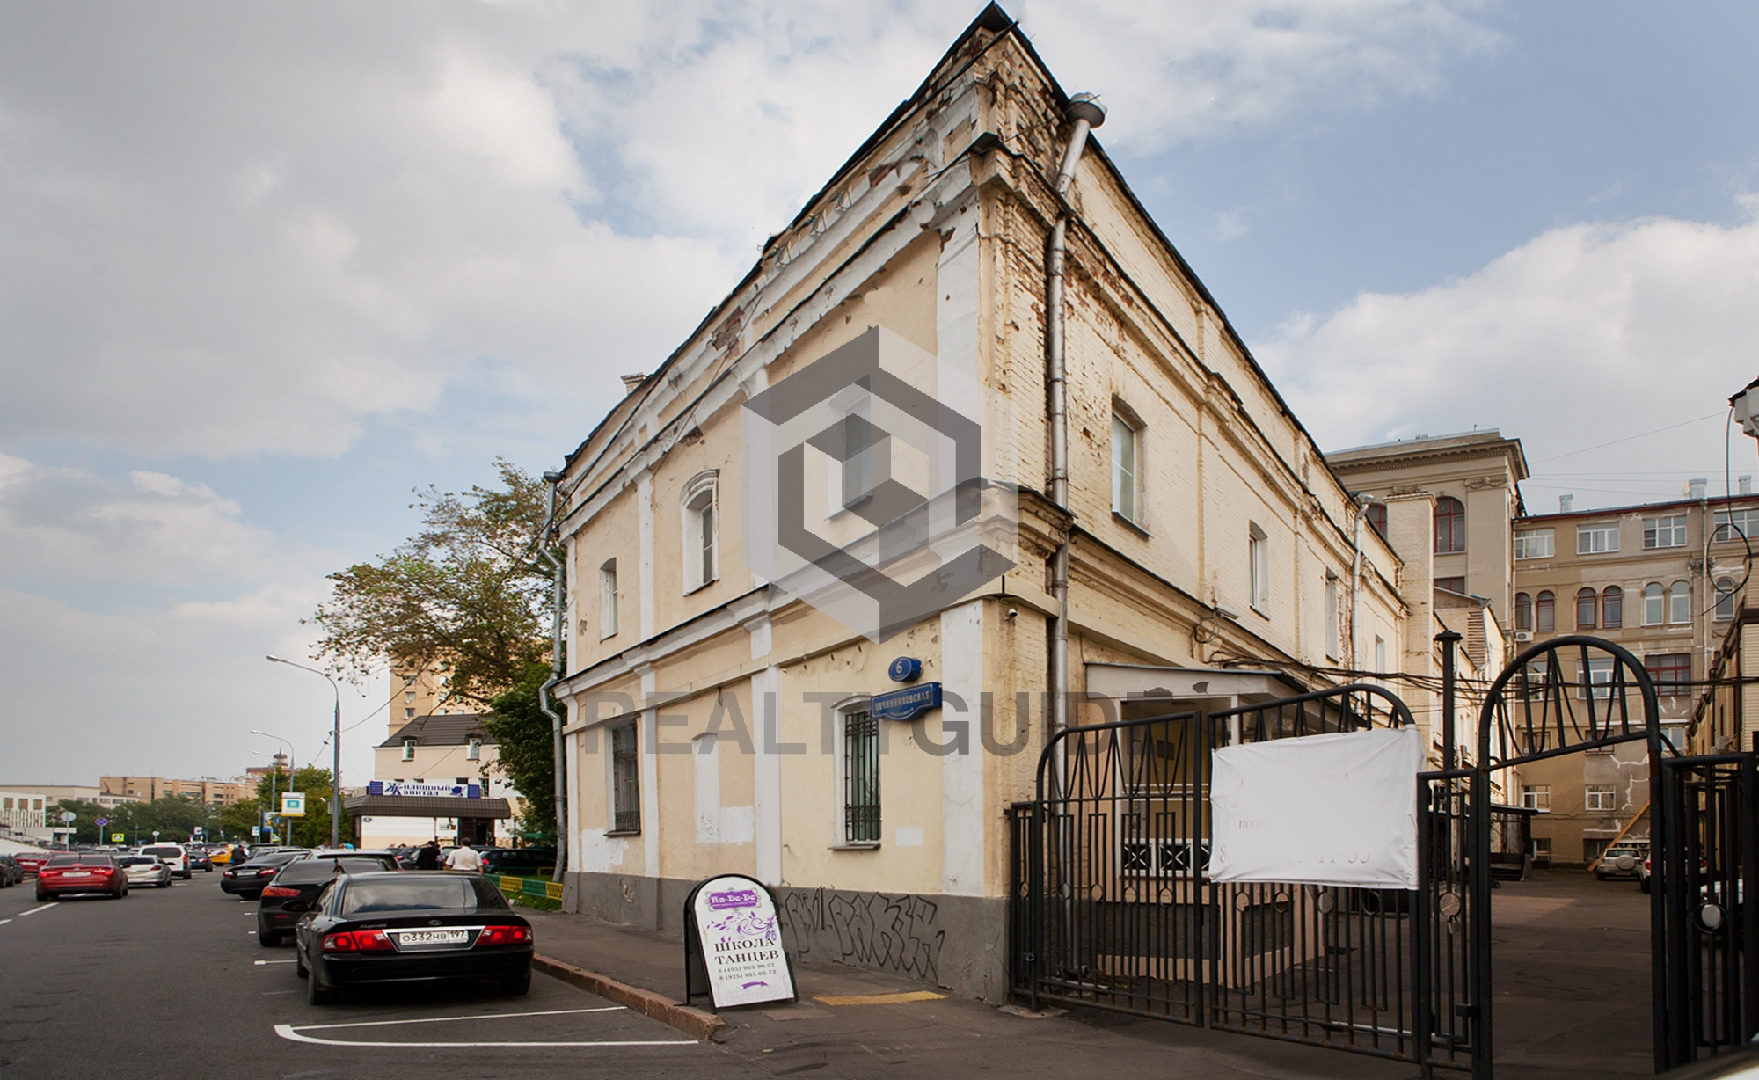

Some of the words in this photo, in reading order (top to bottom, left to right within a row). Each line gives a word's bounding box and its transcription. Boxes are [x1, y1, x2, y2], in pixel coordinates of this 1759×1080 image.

[895, 660, 903, 674] 6
[714, 937, 775, 953] ШКОЛА
[714, 950, 779, 965] ТАНЦЕВ
